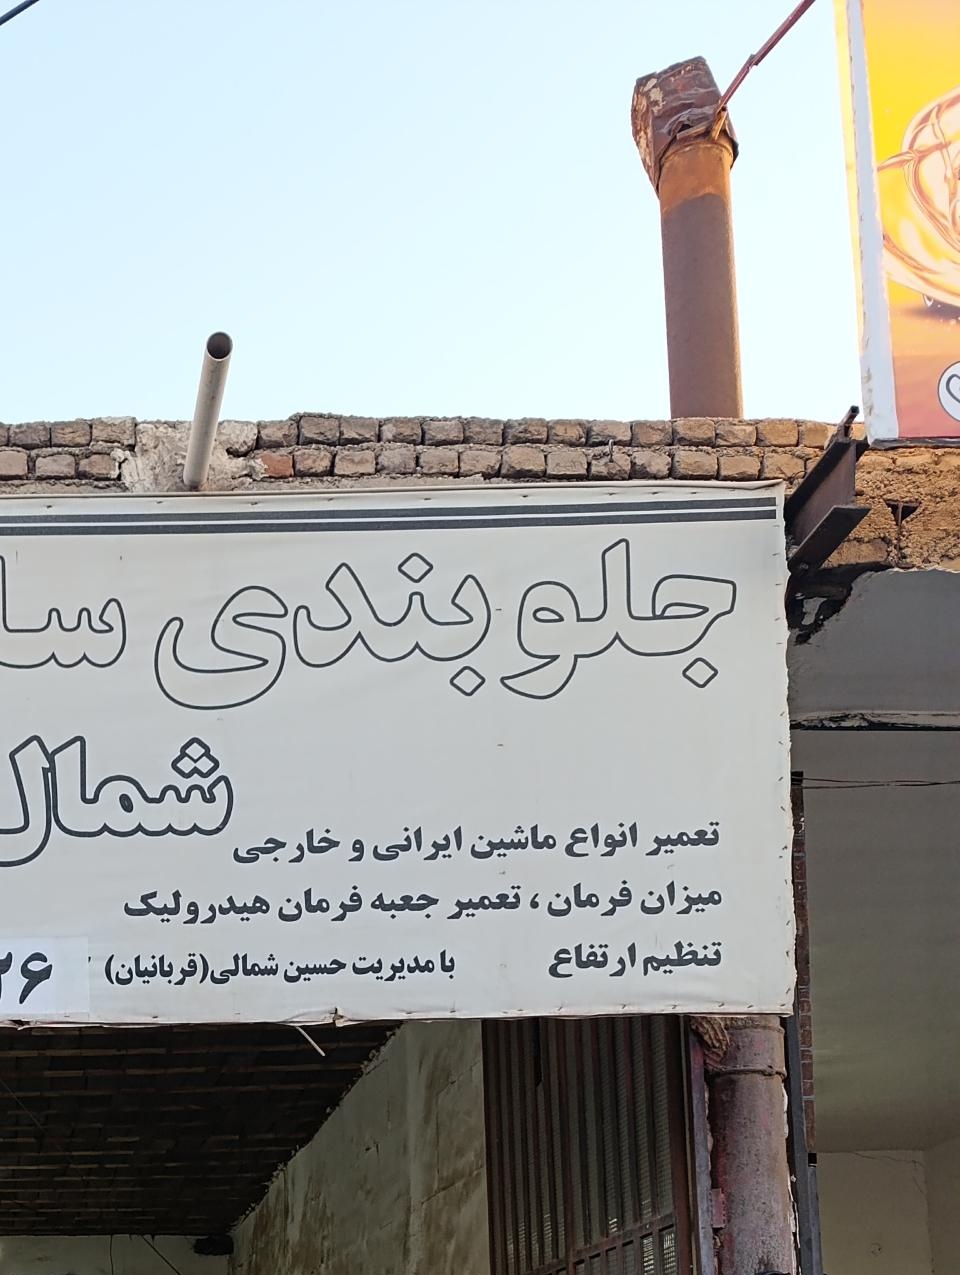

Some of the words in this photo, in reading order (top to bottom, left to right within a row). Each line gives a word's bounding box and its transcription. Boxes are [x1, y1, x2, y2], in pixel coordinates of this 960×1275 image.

[233, 828, 341, 864] خارجی
[349, 839, 366, 862] و
[373, 826, 463, 862] ایرانی
[471, 824, 557, 860] ماشین
[565, 822, 638, 858] انواع
[646, 822, 721, 856] تعمیر
[124, 890, 271, 925] هیدرولیک
[278, 885, 364, 923] فرمان
[371, 893, 441, 919] جعبه
[447, 885, 522, 920] تعمیر
[548, 880, 633, 917] فرمان
[641, 880, 723, 915] میزان
[284, 958, 347, 984] حسین
[352, 956, 435, 982] مدیریت
[440, 949, 456, 979] با
[549, 942, 637, 979] ارتفاع
[643, 940, 723, 977] تنظیم
